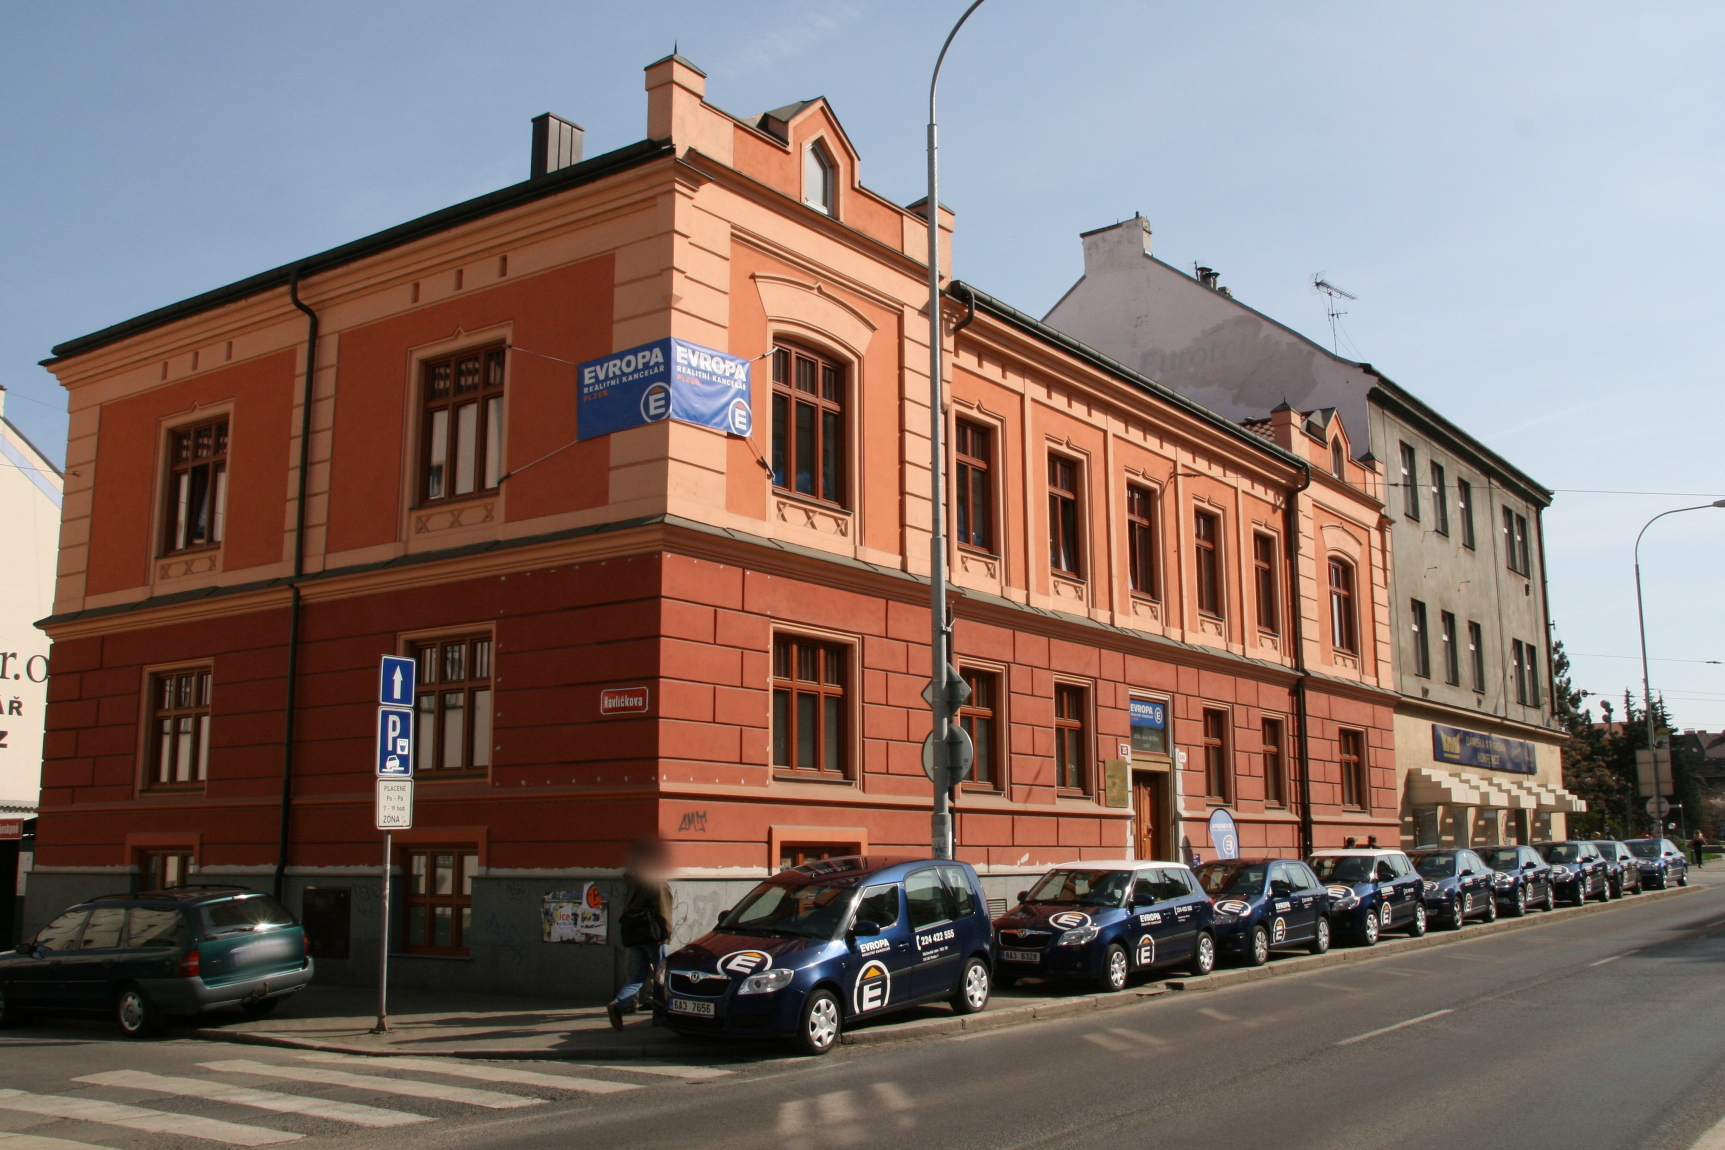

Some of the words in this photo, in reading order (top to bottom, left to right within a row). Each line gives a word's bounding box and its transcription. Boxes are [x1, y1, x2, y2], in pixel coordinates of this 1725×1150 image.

[584, 347, 665, 385] EVROPA
[676, 345, 747, 382] EVROPA
[584, 379, 620, 394] REALITNÍ
[622, 364, 665, 383] KANCELÁŘ
[676, 365, 710, 380] REALITNÍ
[712, 374, 747, 391] KANCELÁŘ
[604, 695, 643, 708] Havlíčkova
[1130, 704, 1153, 714] EVROPA
[387, 714, 401, 751] P
[383, 813, 400, 823] ZÓNA
[1275, 901, 1291, 910] EVROPA
[1140, 913, 1161, 922] EVROPA
[921, 934, 932, 945] 224
[933, 932, 944, 942] 422
[944, 929, 954, 939] 555
[860, 938, 890, 953] EVROPA
[1021, 952, 1037, 961] 6328
[673, 999, 688, 1012] 6A3
[692, 1002, 711, 1014] 7656
